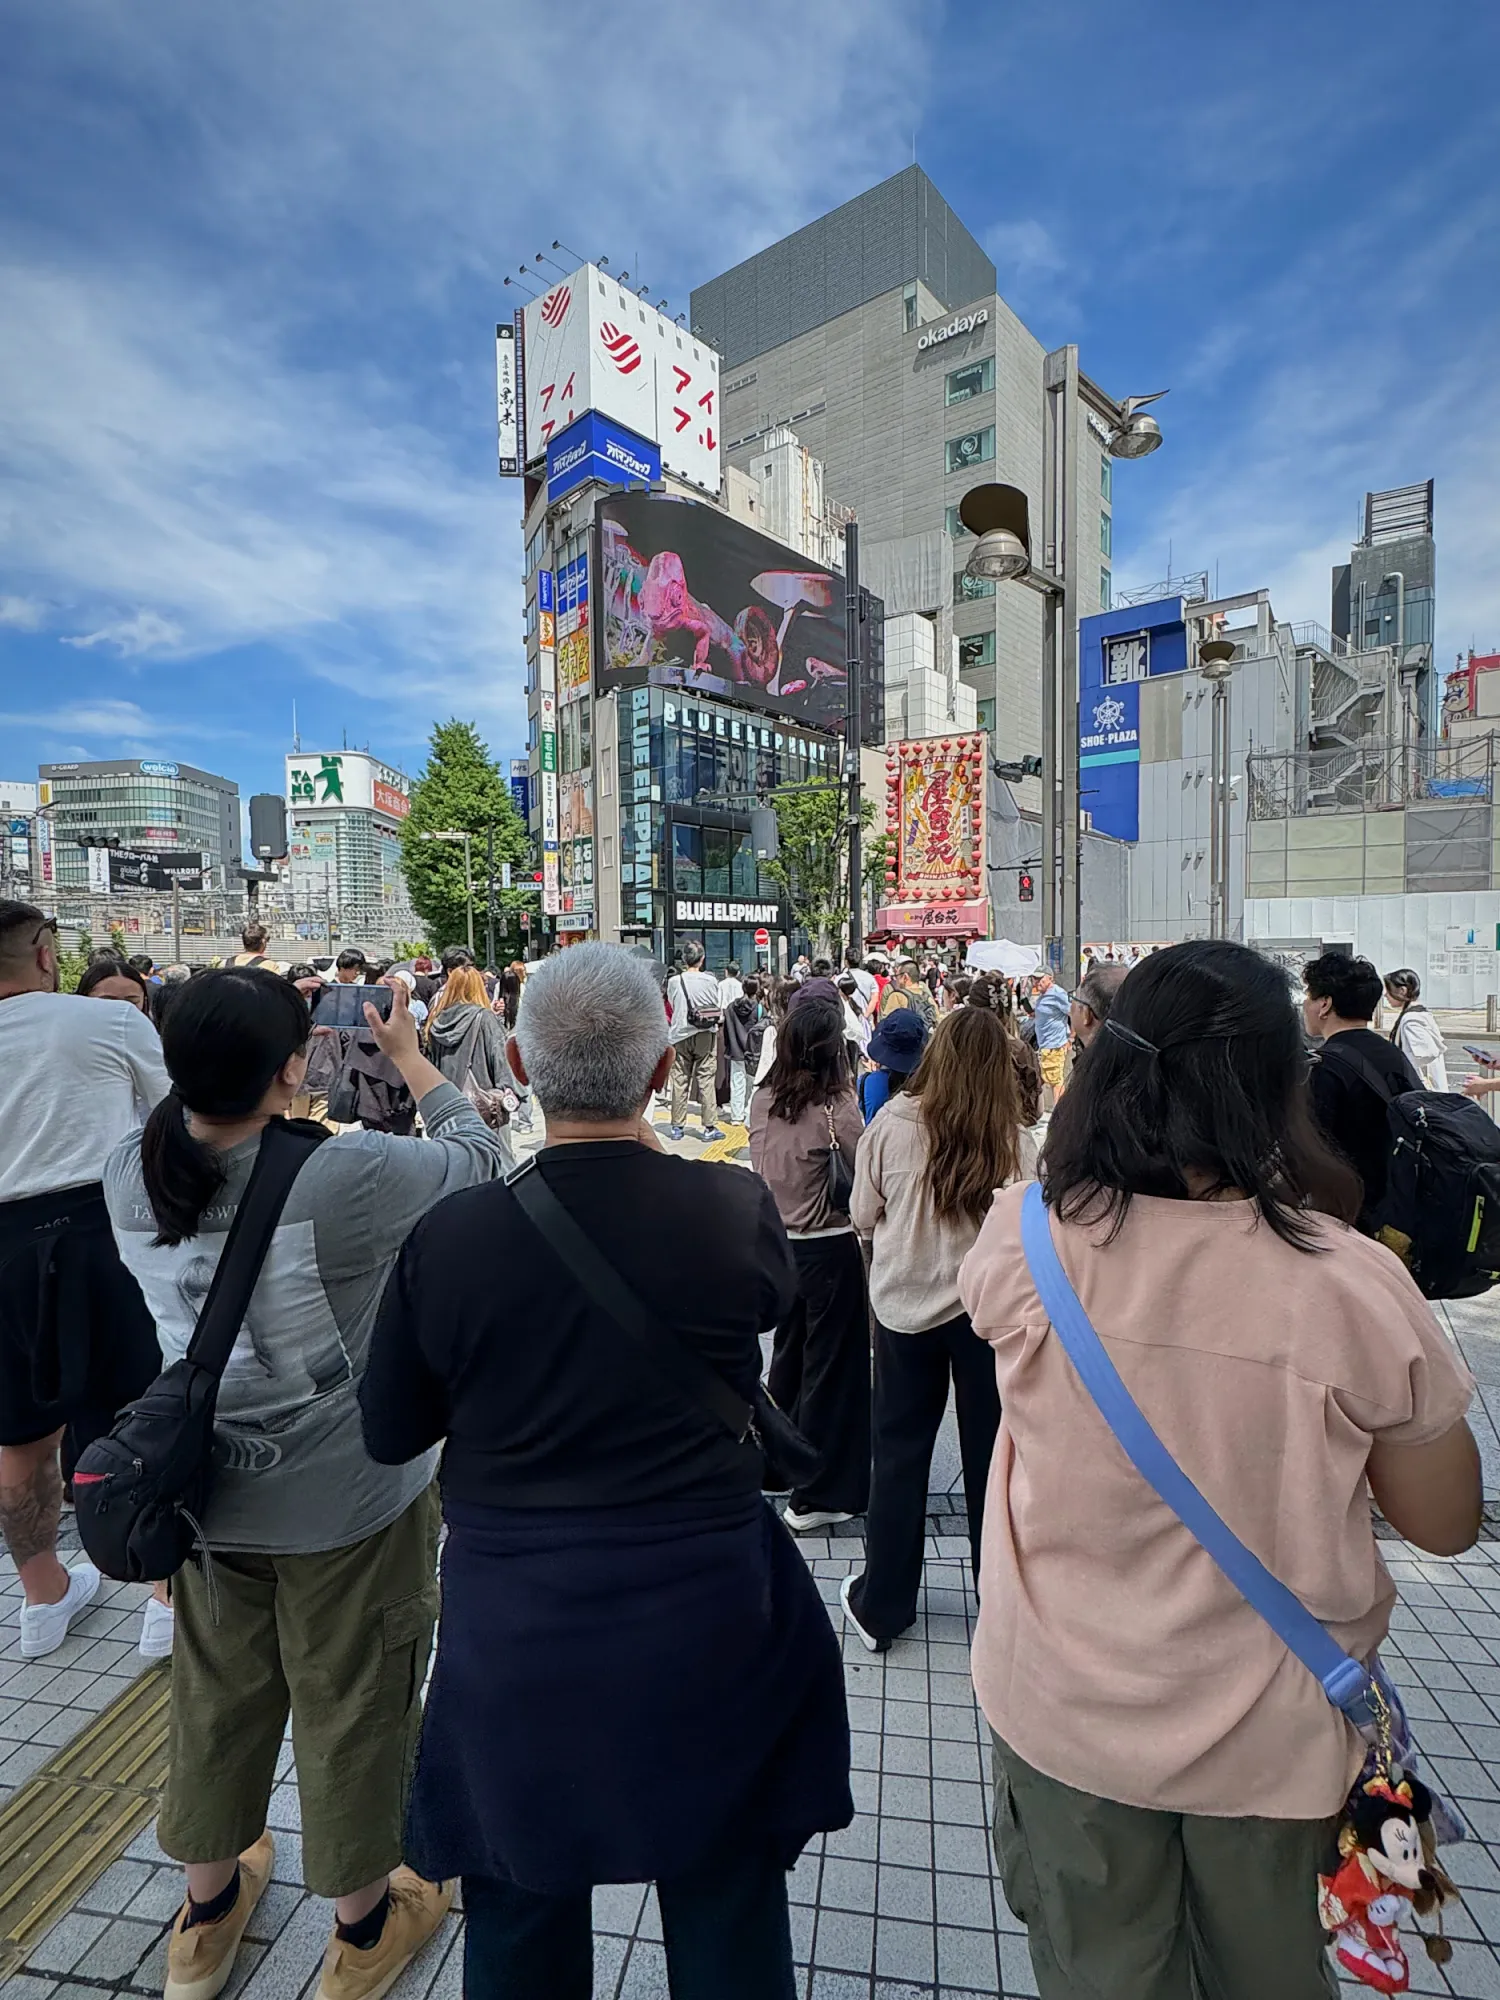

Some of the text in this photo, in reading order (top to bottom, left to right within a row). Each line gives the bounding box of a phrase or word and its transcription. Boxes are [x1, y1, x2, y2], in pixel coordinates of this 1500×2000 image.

[917, 308, 988, 350] okadaya
[1109, 640, 1147, 684] 靴
[664, 701, 725, 737] BLUE
[163, 868, 200, 876] WILLROSE
[676, 900, 779, 923] BLUE ELEPHANT
